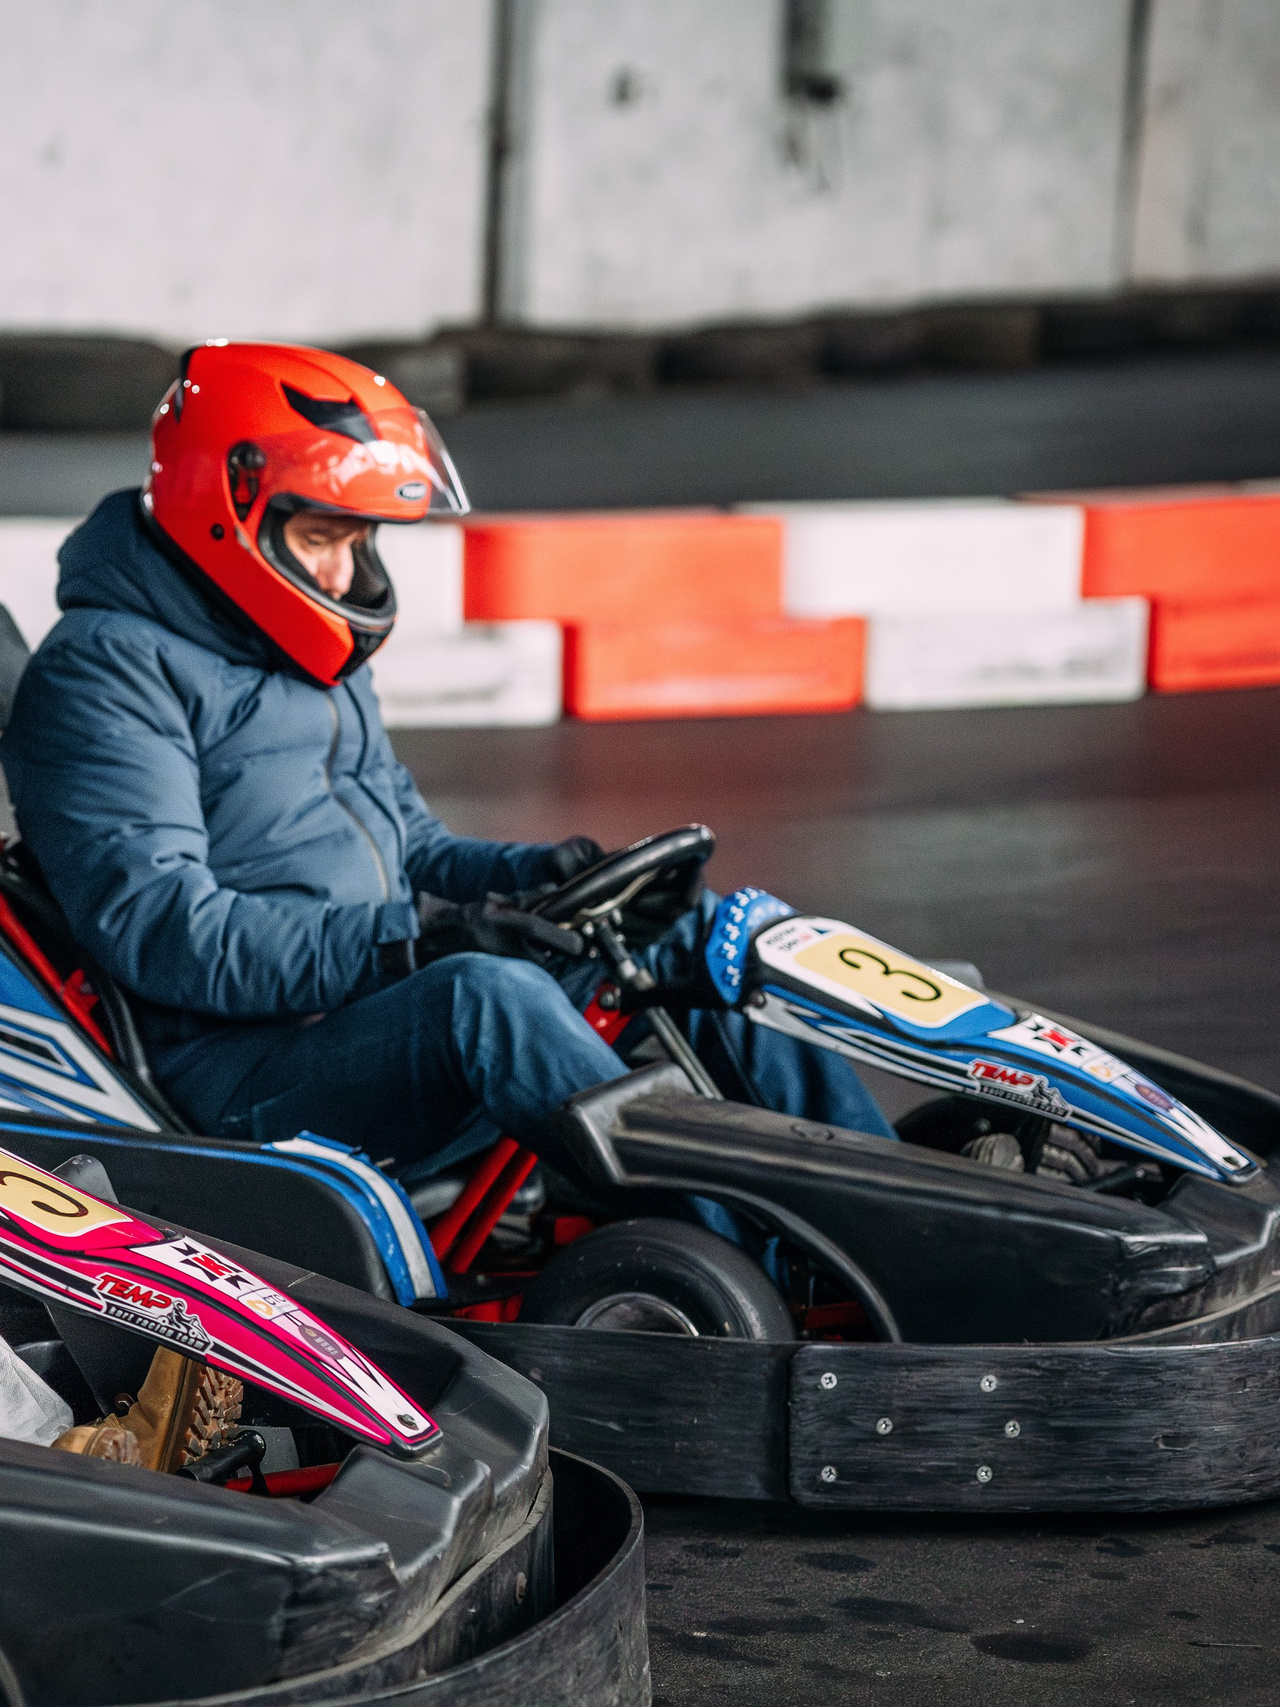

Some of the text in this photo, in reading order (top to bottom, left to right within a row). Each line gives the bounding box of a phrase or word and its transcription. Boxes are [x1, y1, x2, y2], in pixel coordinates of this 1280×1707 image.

[838, 948, 942, 1002] 3
[971, 1062, 1035, 1086] TEMP
[97, 1274, 172, 1309] TEMP
[108, 1306, 205, 1349] kart racing team
